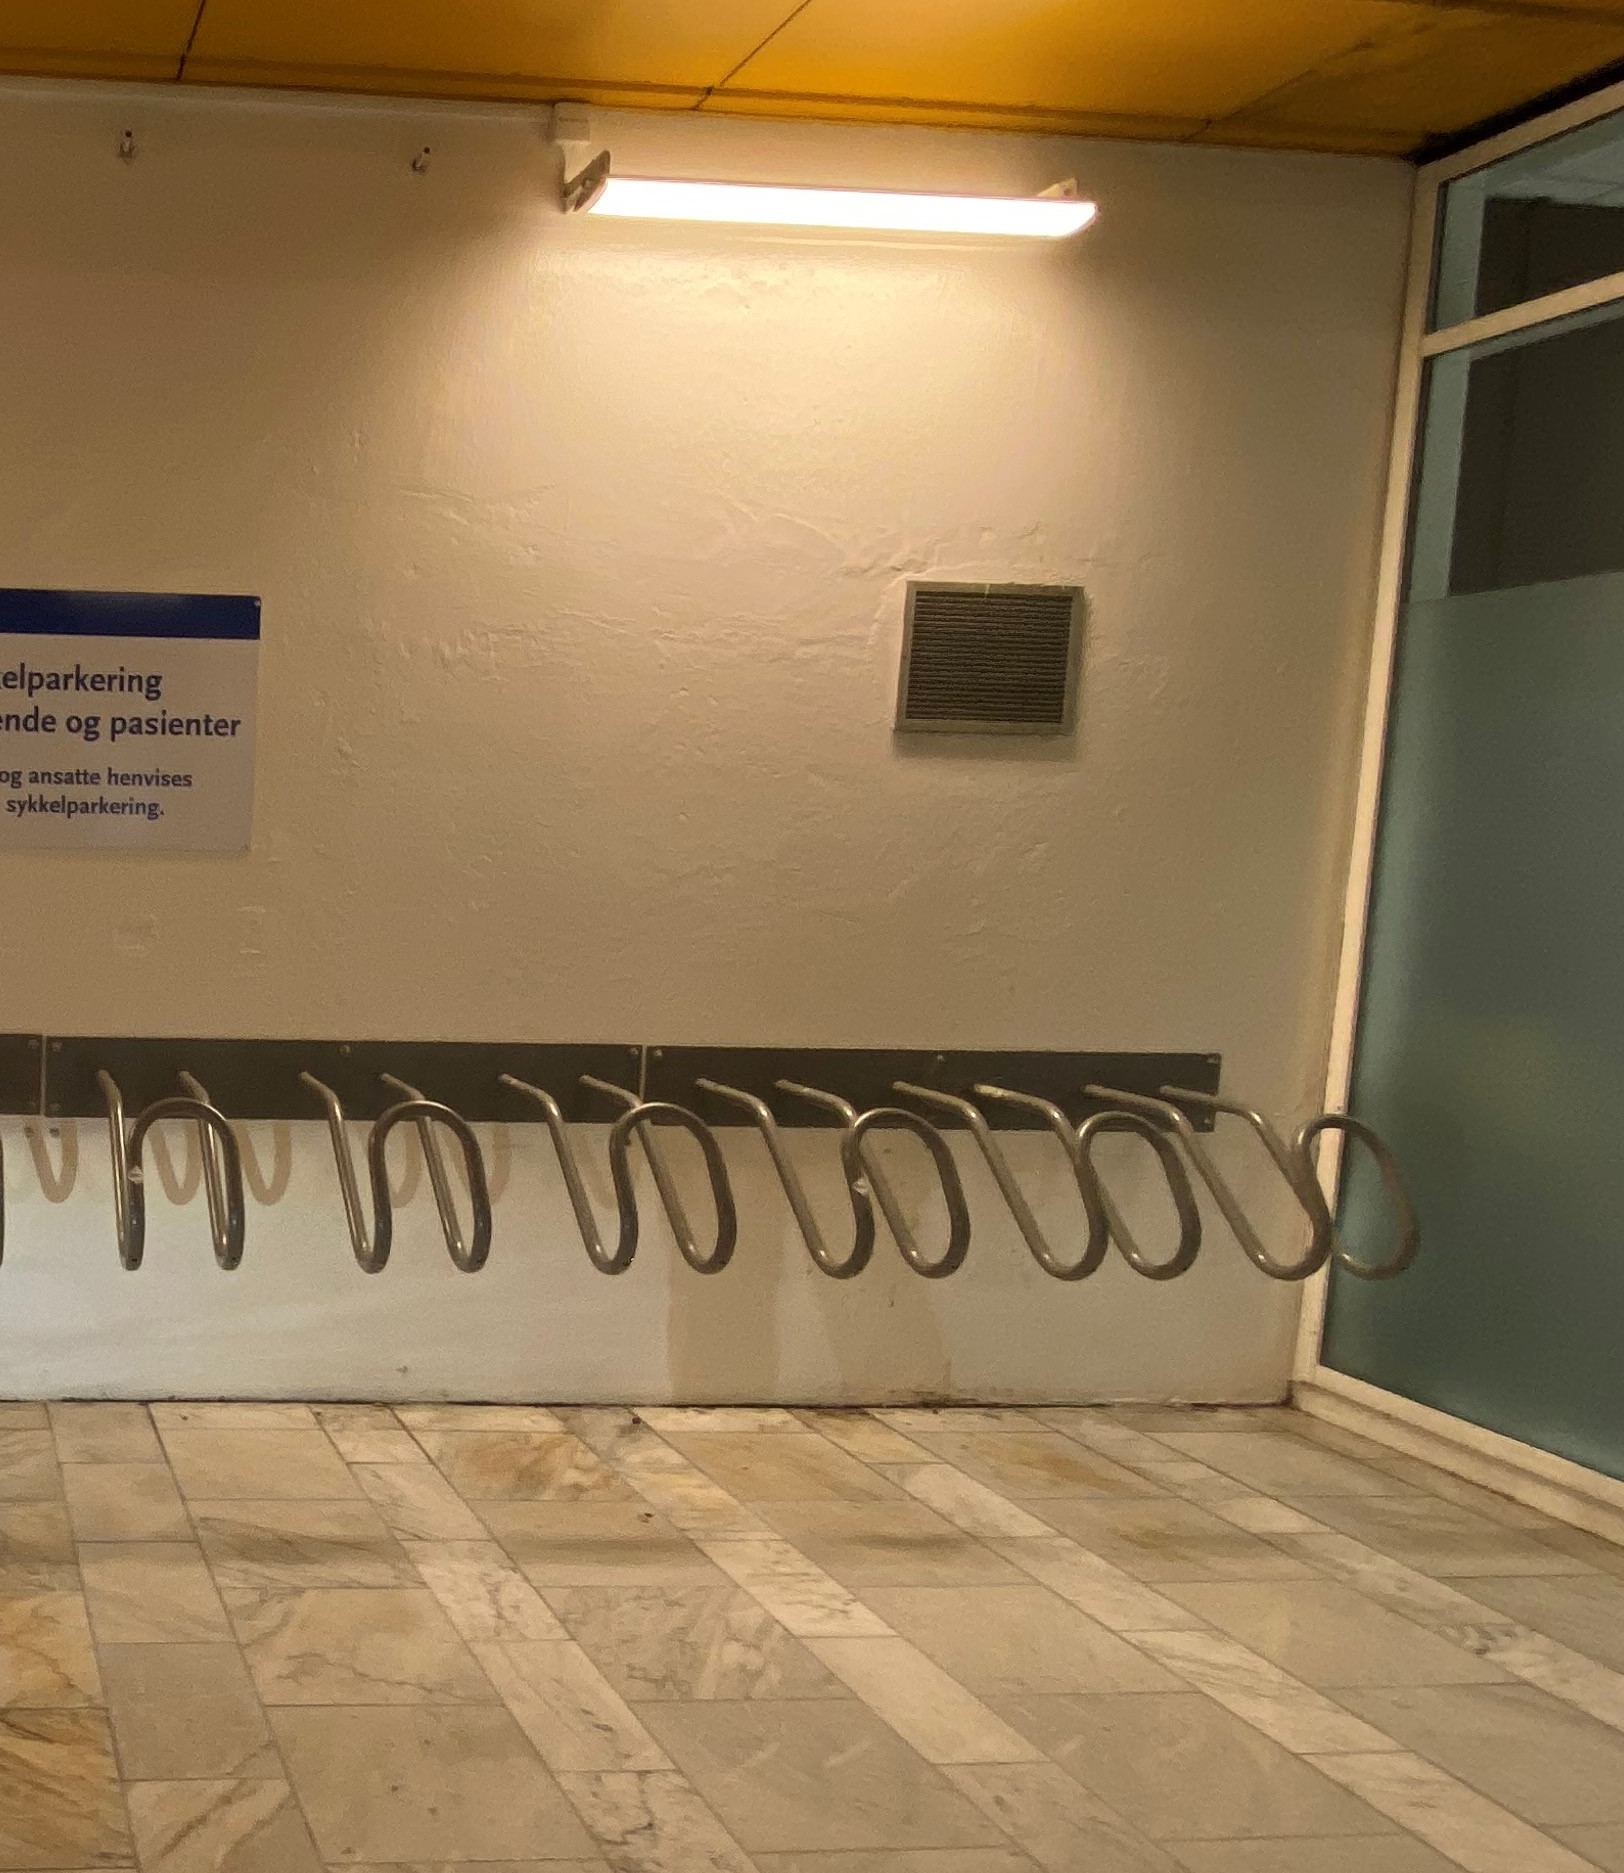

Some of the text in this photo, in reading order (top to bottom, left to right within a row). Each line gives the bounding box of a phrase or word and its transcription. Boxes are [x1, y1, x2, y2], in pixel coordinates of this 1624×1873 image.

[65, 715, 101, 742] og
[111, 709, 242, 742] pasienter
[29, 768, 101, 786] ansatte
[107, 768, 193, 787] henvises
[6, 795, 165, 821] sykkelparkering.
